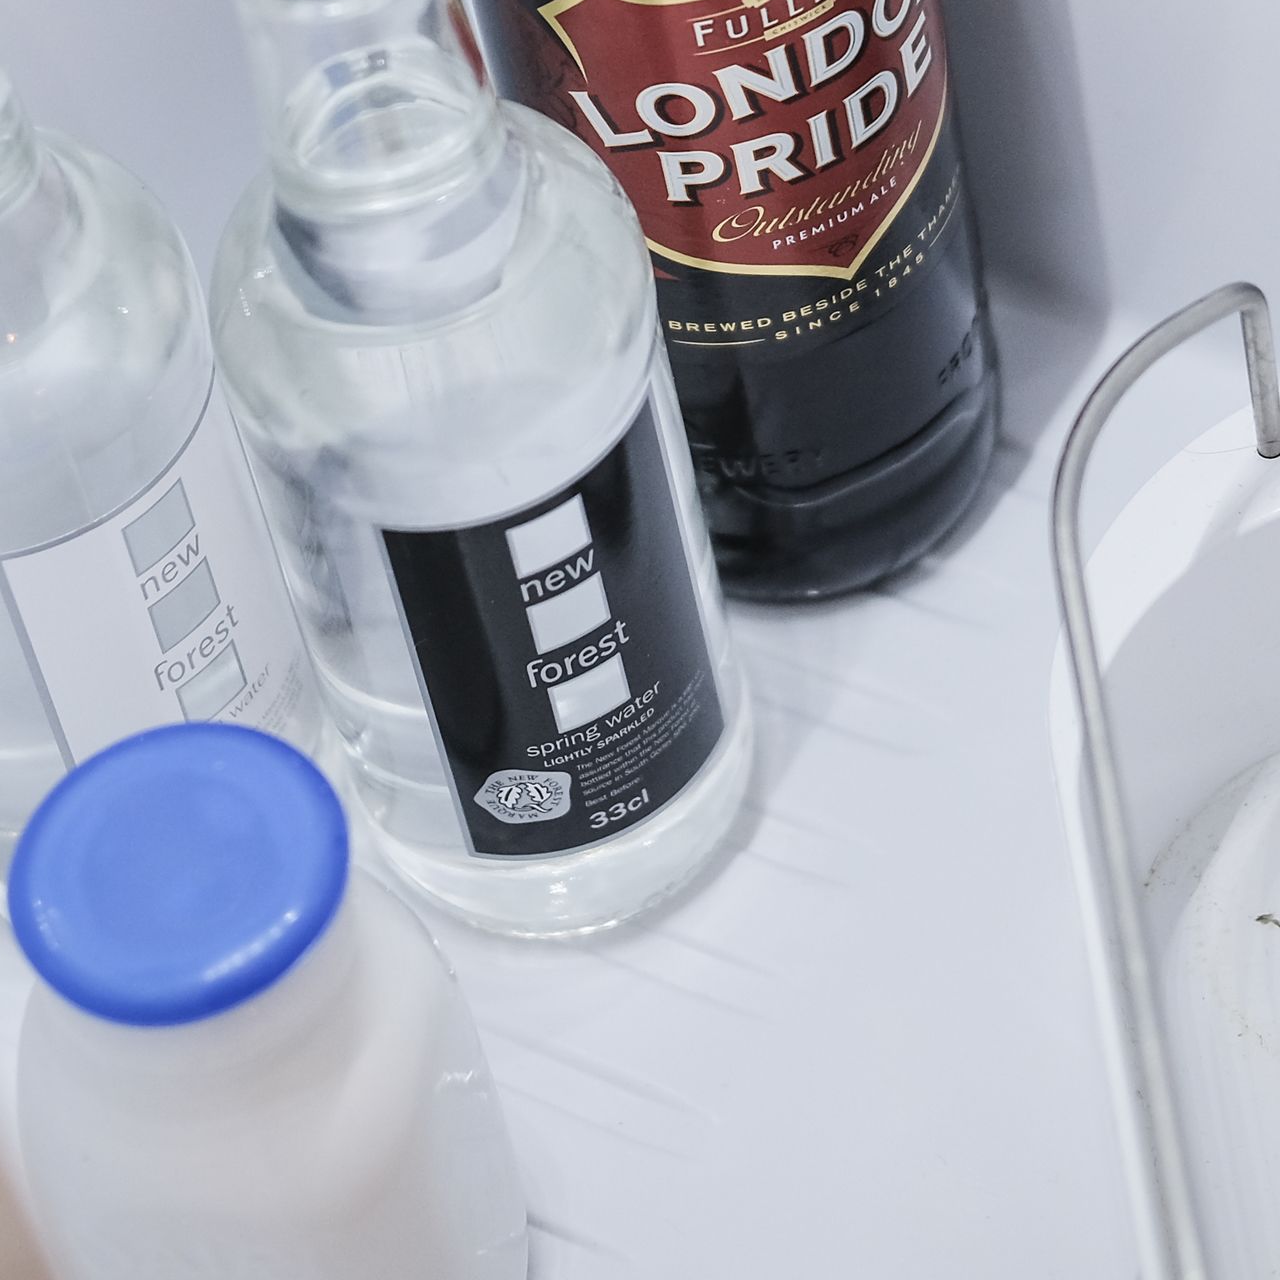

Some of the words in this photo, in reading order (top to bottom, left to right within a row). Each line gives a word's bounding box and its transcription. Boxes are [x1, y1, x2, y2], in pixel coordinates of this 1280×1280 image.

[772, 4, 827, 35] CHISWICK
[656, 9, 933, 204] PRIDE
[711, 119, 923, 243] Outstanding
[772, 201, 865, 250] PREMIUM
[870, 176, 898, 205] ALE
[668, 317, 772, 333] BREWED
[782, 278, 868, 322] BESIDE
[874, 244, 914, 277] THE
[775, 300, 861, 340] SINCE
[875, 252, 924, 297] 1845
[138, 533, 201, 600] new
[520, 548, 594, 602] new
[154, 605, 240, 691] forest
[526, 620, 630, 688] forest
[229, 662, 270, 718] water
[526, 723, 601, 757] spring
[605, 681, 660, 728] water
[543, 745, 593, 768] LIGHTLY
[597, 708, 655, 749] SPARKLED
[485, 781, 504, 794] THE
[508, 774, 538, 783] NEW
[543, 778, 564, 806] FOREST
[486, 800, 539, 819] MARQUE
[589, 788, 649, 828] 33cl
